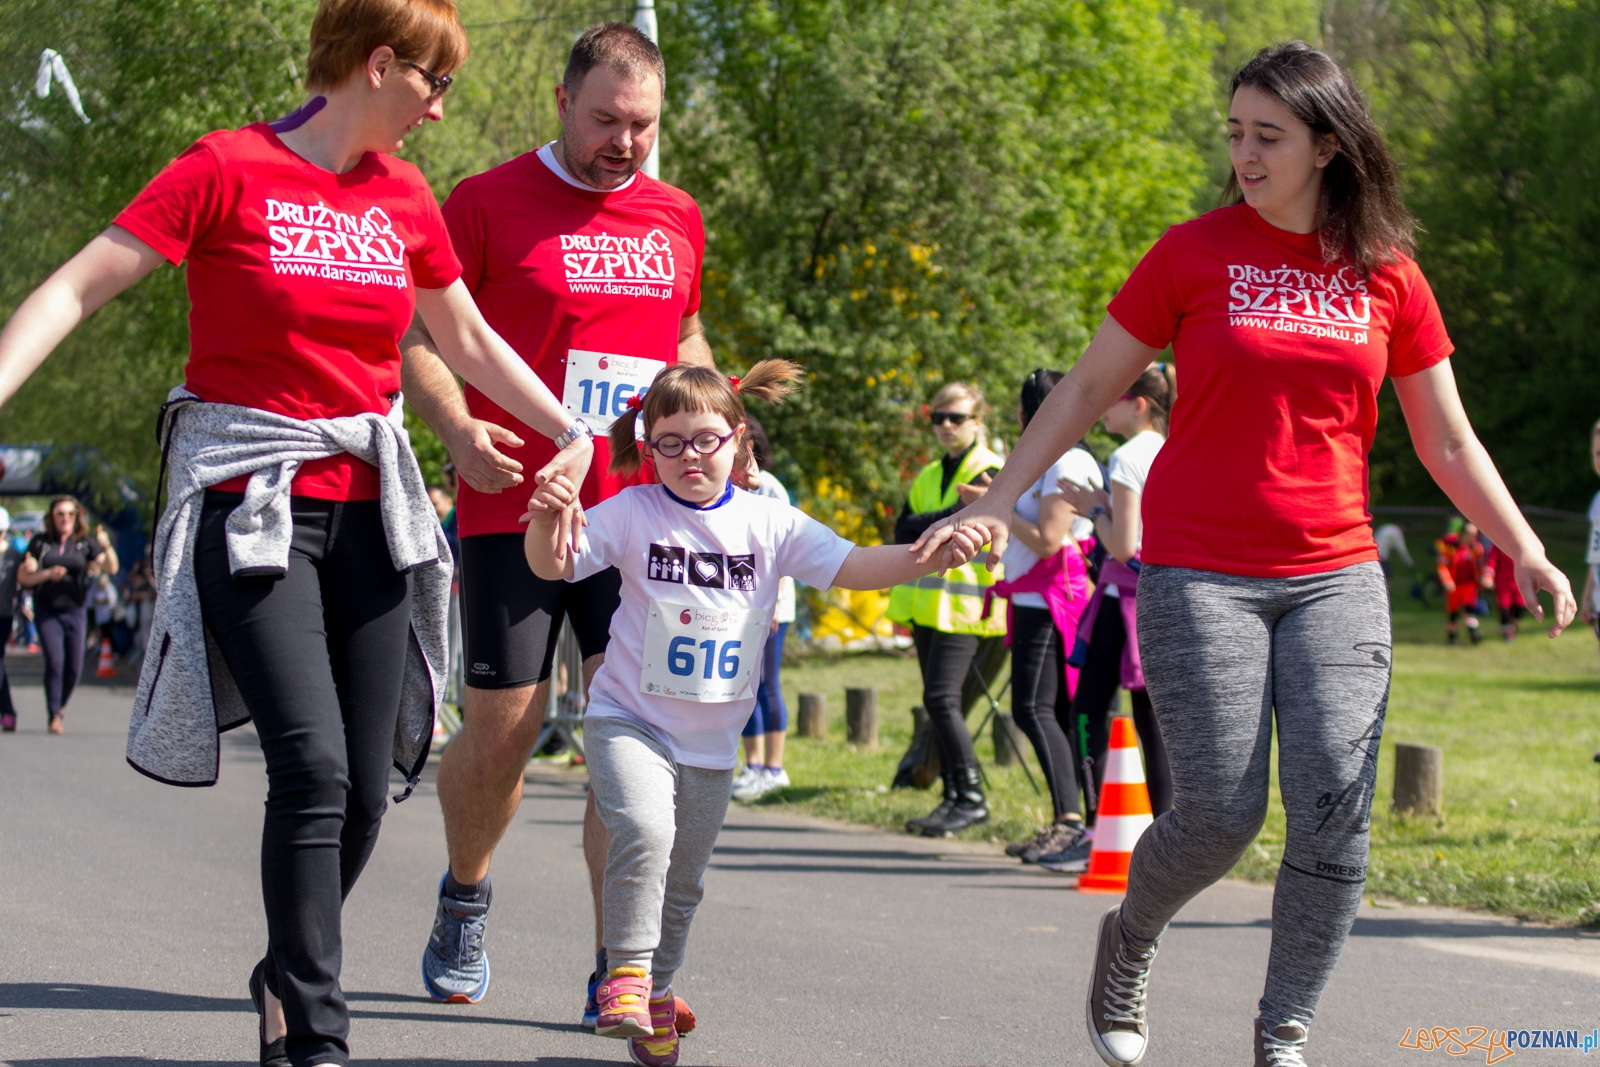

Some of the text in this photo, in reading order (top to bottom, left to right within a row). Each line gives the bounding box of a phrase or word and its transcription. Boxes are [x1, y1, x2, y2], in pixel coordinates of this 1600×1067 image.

[265, 199, 378, 237] DRUŻYNA
[268, 225, 405, 266] SZPIKU
[560, 231, 656, 254] DRUŻYNA
[273, 262, 408, 289] www.darszpiku.pl
[563, 252, 675, 281] SZPIKU
[1227, 264, 1345, 295] DRUŻYNA
[569, 282, 673, 300] www.darszpiku.pl
[1228, 281, 1371, 324] SZPIKU
[1229, 316, 1369, 345] www.darszpiku.pl
[694, 608, 719, 626] bieg
[667, 635, 742, 680] 616
